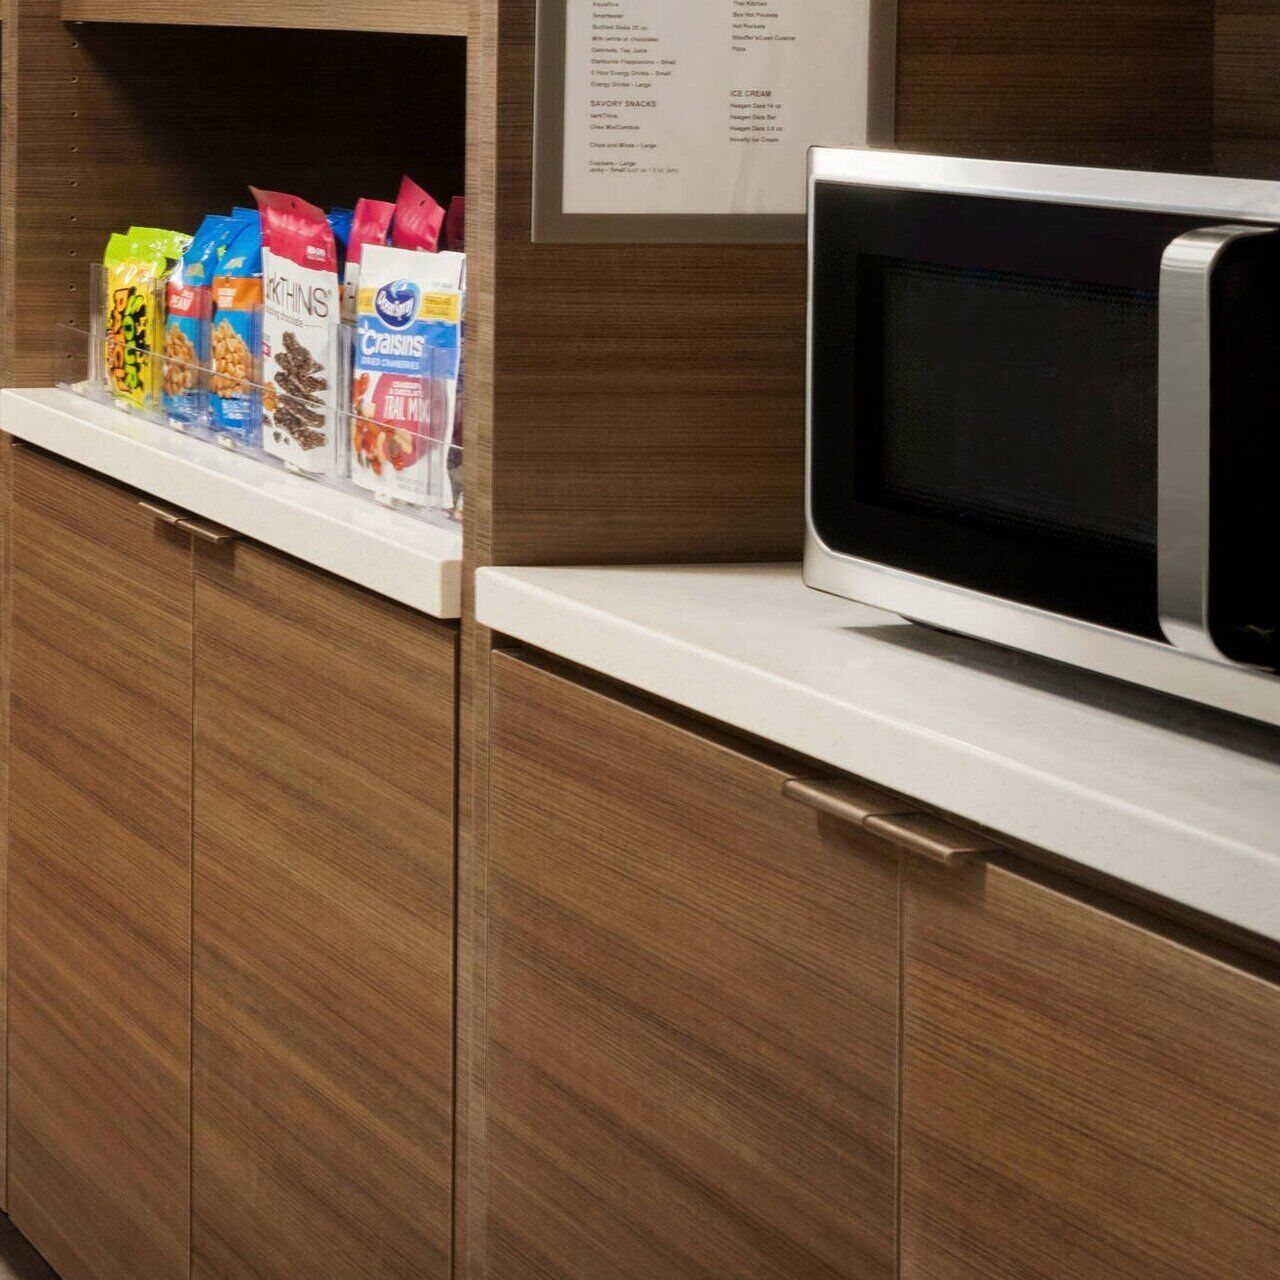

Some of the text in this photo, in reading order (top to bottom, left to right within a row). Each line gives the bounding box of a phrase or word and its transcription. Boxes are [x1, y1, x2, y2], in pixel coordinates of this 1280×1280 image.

[590, 100, 657, 108] SAVORY SNACKS
[361, 331, 424, 359] Craisins
